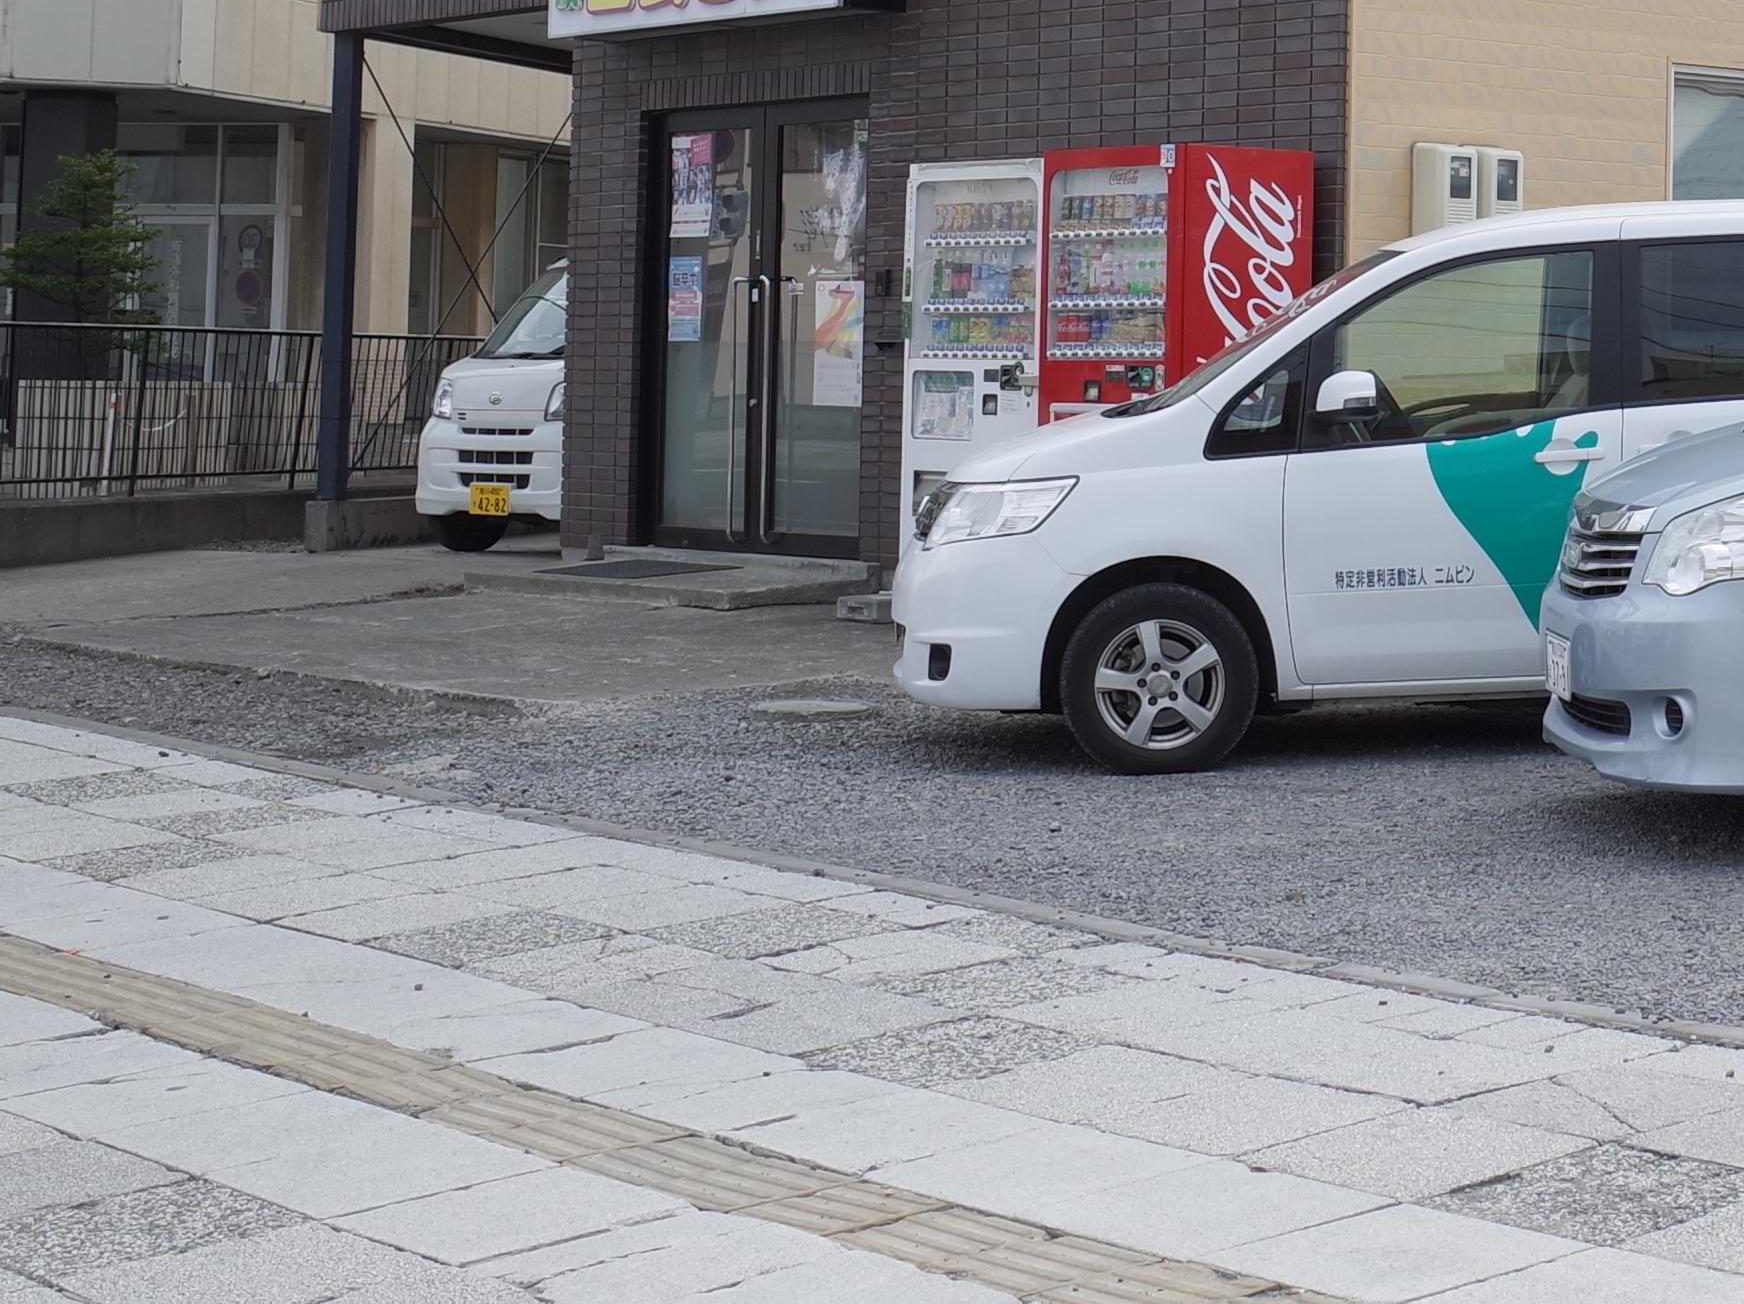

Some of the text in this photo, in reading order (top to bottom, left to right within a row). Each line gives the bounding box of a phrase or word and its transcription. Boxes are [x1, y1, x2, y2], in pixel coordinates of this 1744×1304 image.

[477, 497, 507, 513] 42-82
[1334, 567, 1428, 590] 特定非営利活動法人
